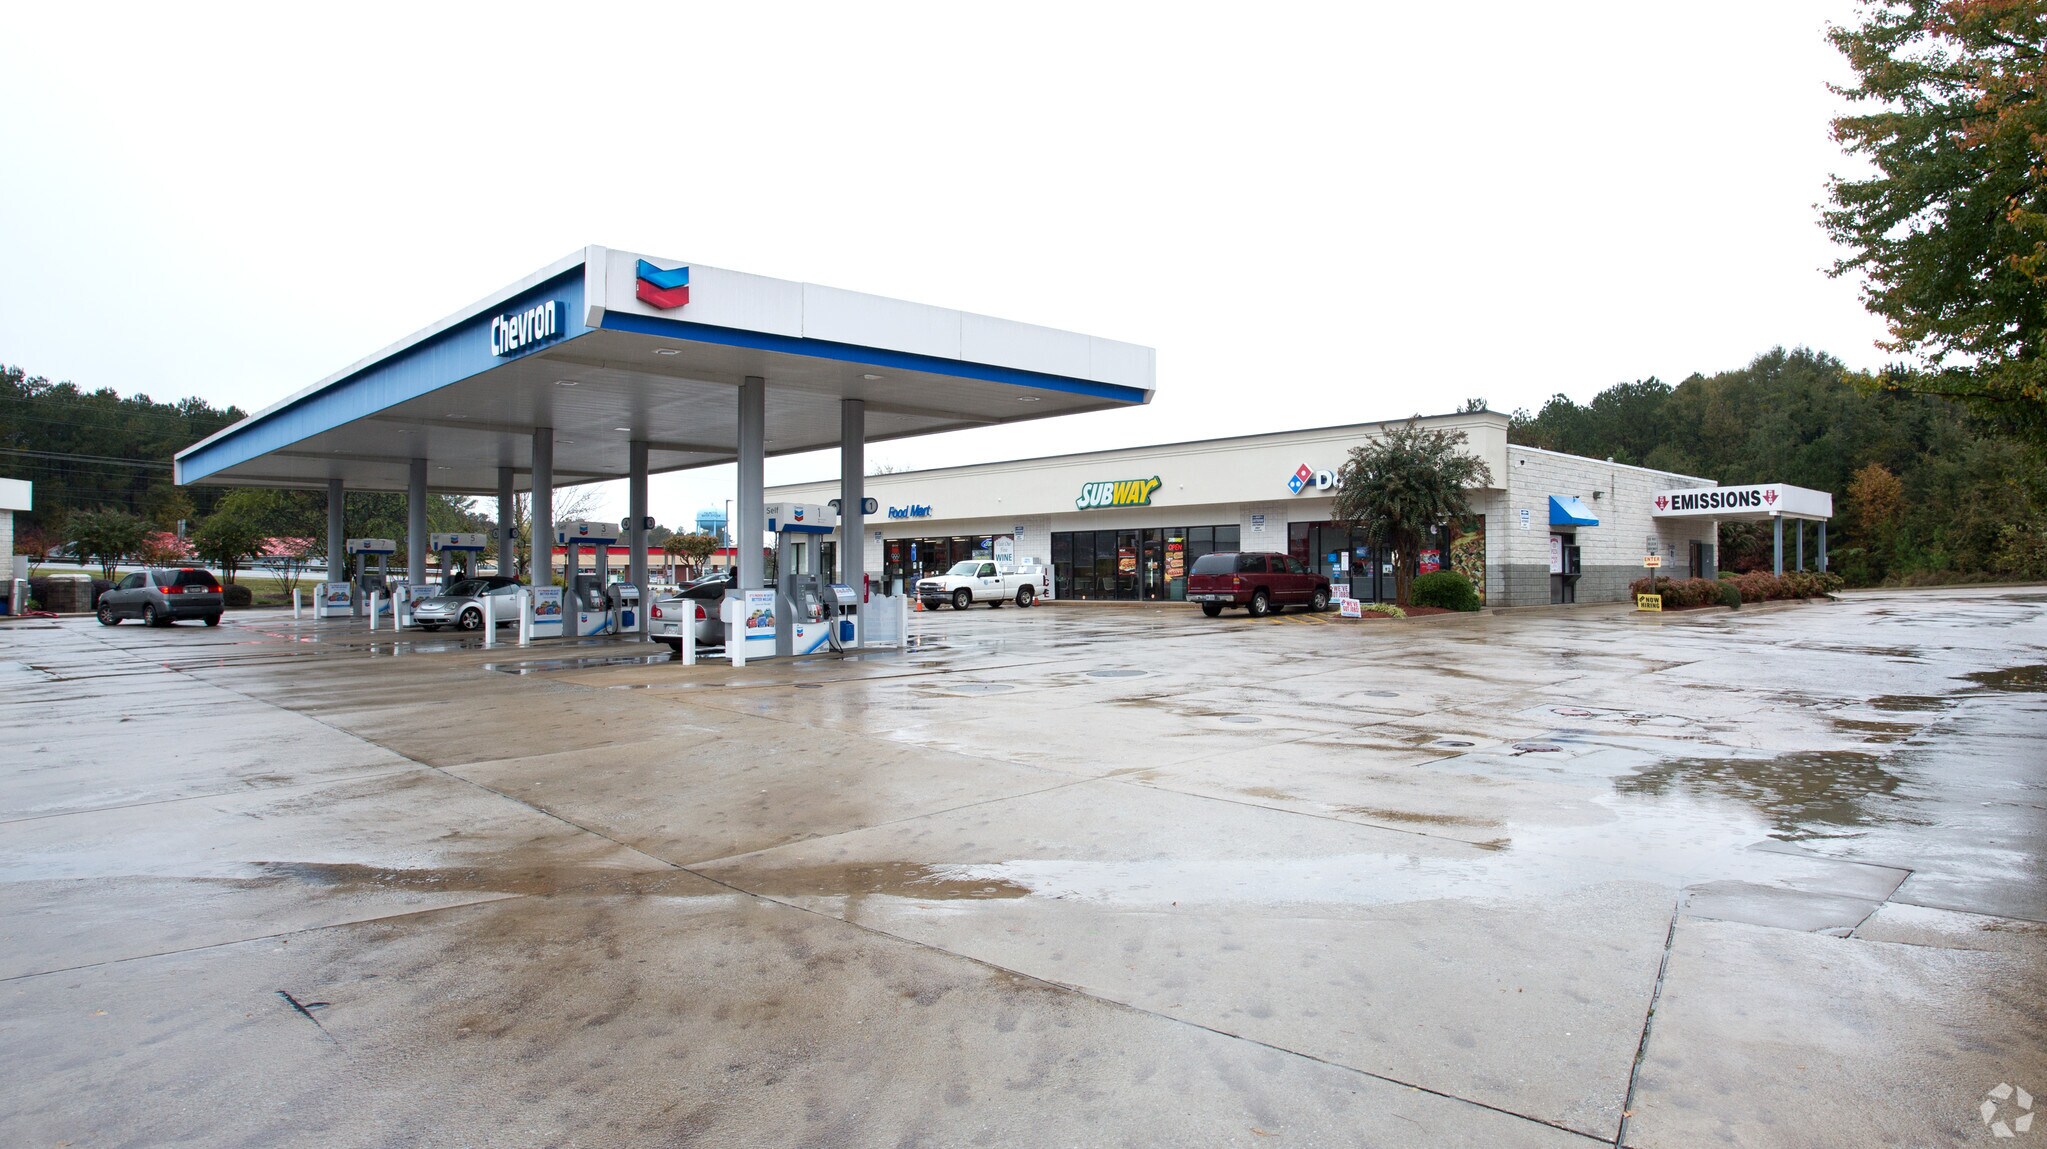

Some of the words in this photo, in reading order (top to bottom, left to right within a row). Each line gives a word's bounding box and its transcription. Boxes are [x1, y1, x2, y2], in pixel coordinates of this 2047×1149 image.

[491, 300, 555, 357] Chevron
[1076, 478, 1159, 508] SUBWAY
[1671, 490, 1761, 510] EMISSIONS
[766, 506, 779, 515] Self
[869, 504, 873, 513] 1
[888, 505, 909, 518] Food
[910, 504, 931, 517] Mart
[601, 524, 607, 533] 3
[1168, 543, 1183, 551] OPEN
[996, 553, 1013, 561] WINE
